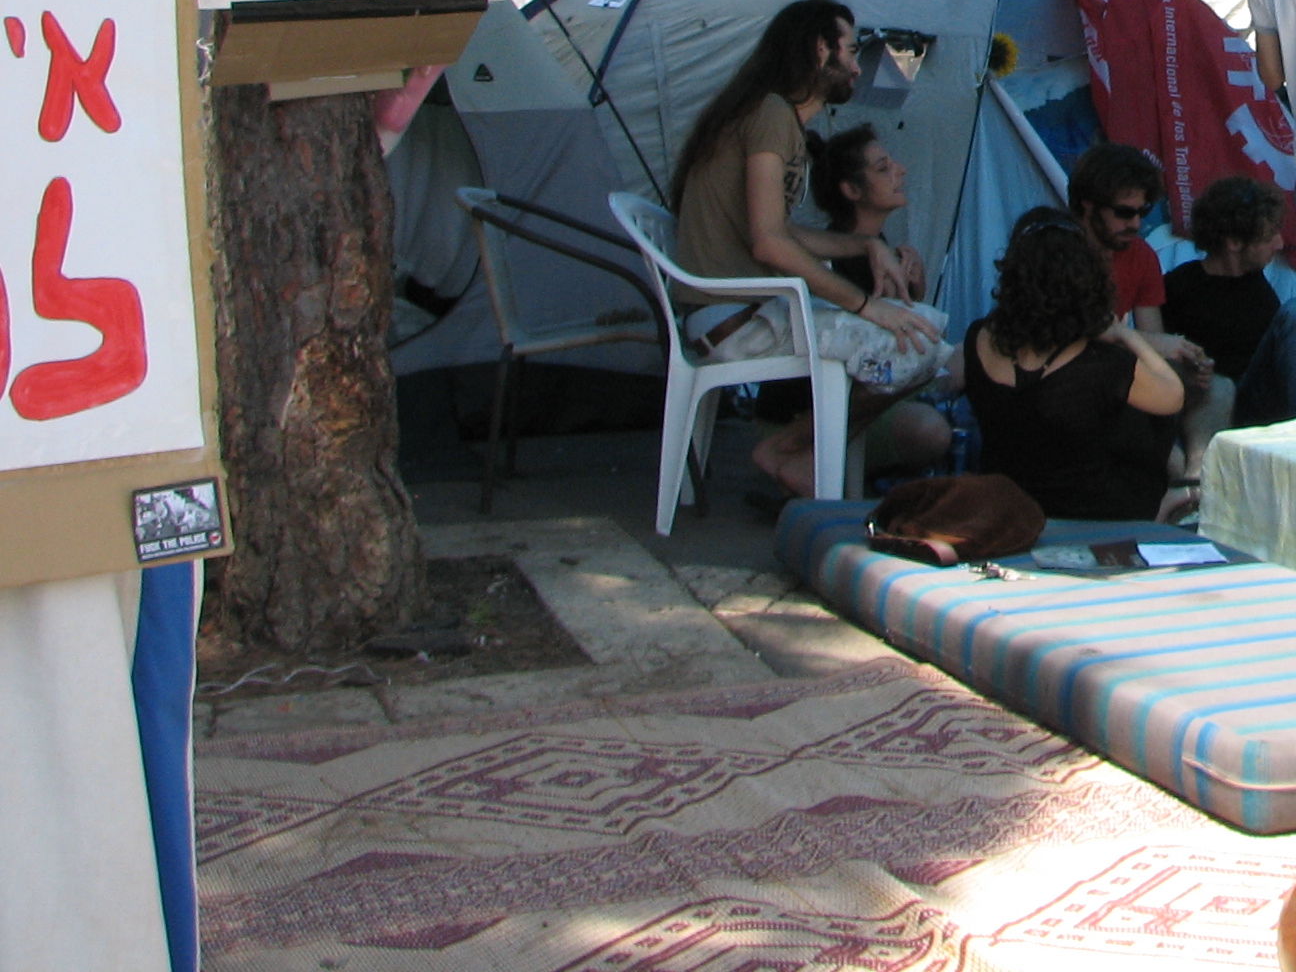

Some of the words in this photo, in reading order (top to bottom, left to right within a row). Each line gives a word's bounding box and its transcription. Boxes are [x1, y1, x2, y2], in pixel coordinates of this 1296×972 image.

[1163, 6, 1182, 98] Internacional
[1172, 101, 1183, 118] de
[1174, 121, 1186, 142] los
